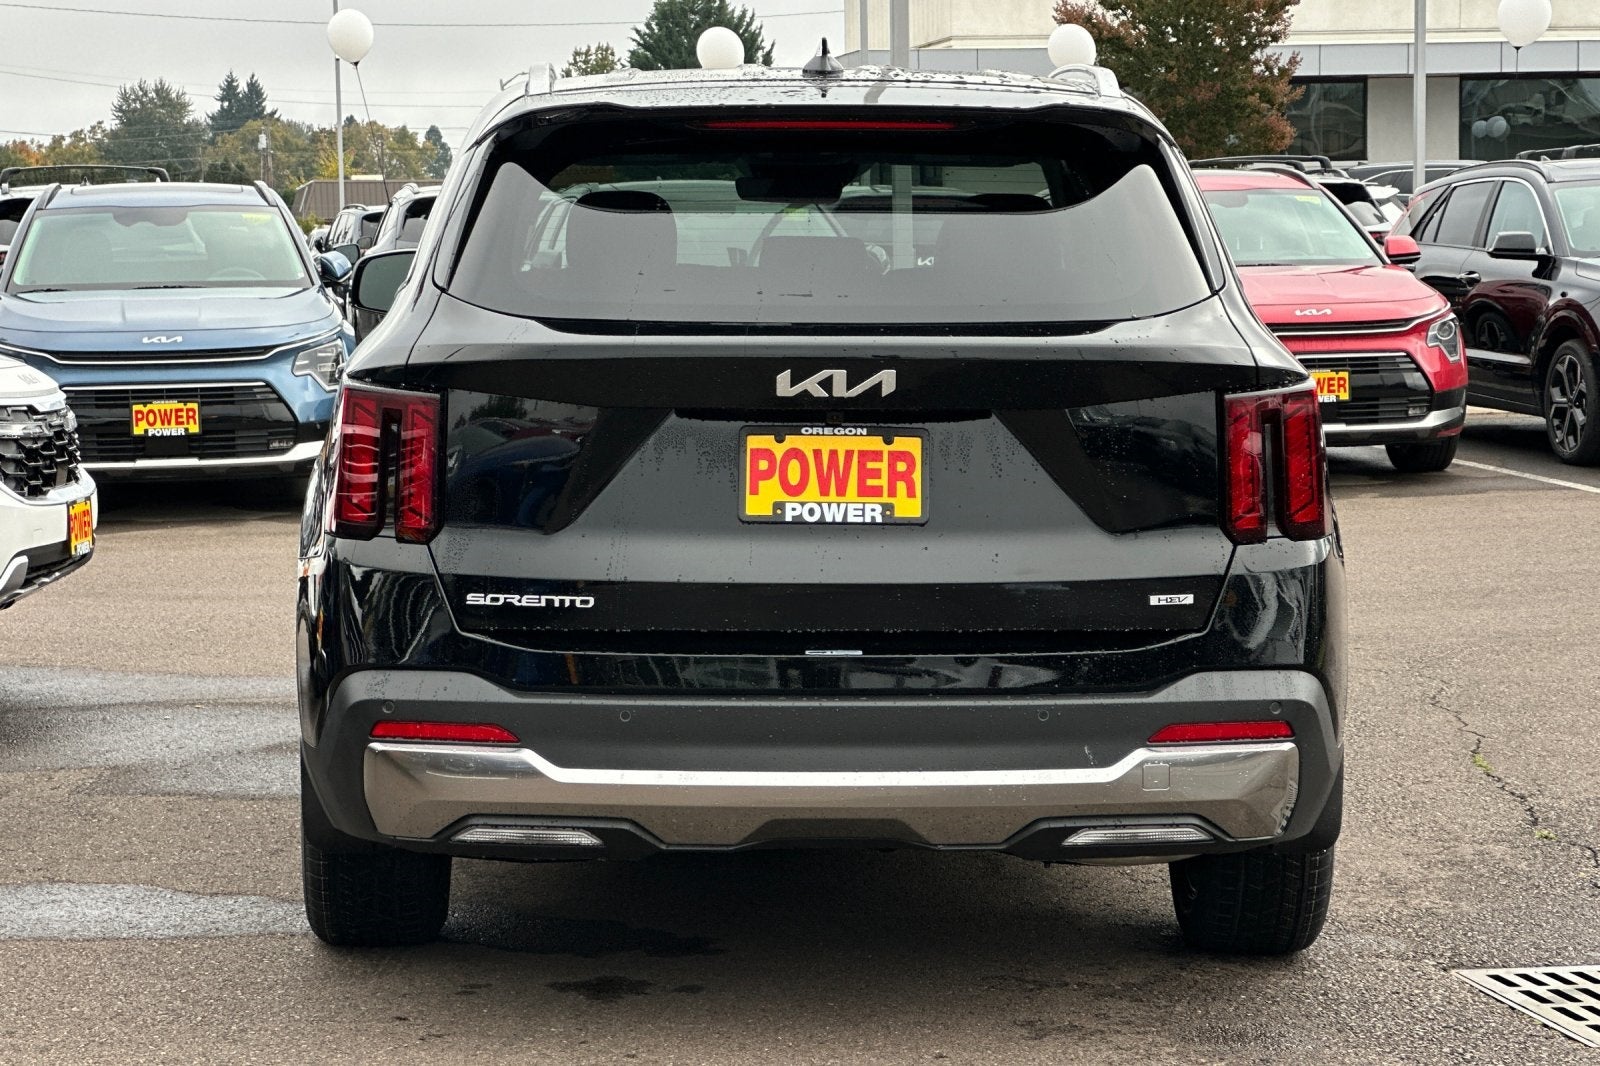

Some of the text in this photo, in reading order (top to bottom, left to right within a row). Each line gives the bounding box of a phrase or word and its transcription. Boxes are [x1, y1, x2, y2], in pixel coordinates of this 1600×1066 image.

[142, 335, 183, 344] KIA
[776, 369, 897, 398] KIA
[1316, 376, 1347, 394] WER
[134, 407, 197, 428] POWER
[147, 428, 186, 437] POWER
[800, 427, 868, 436] OREGON
[749, 447, 917, 499] POWER
[785, 502, 883, 523] POWER
[466, 593, 595, 608] SORENTO
[1157, 595, 1189, 604] HEV
